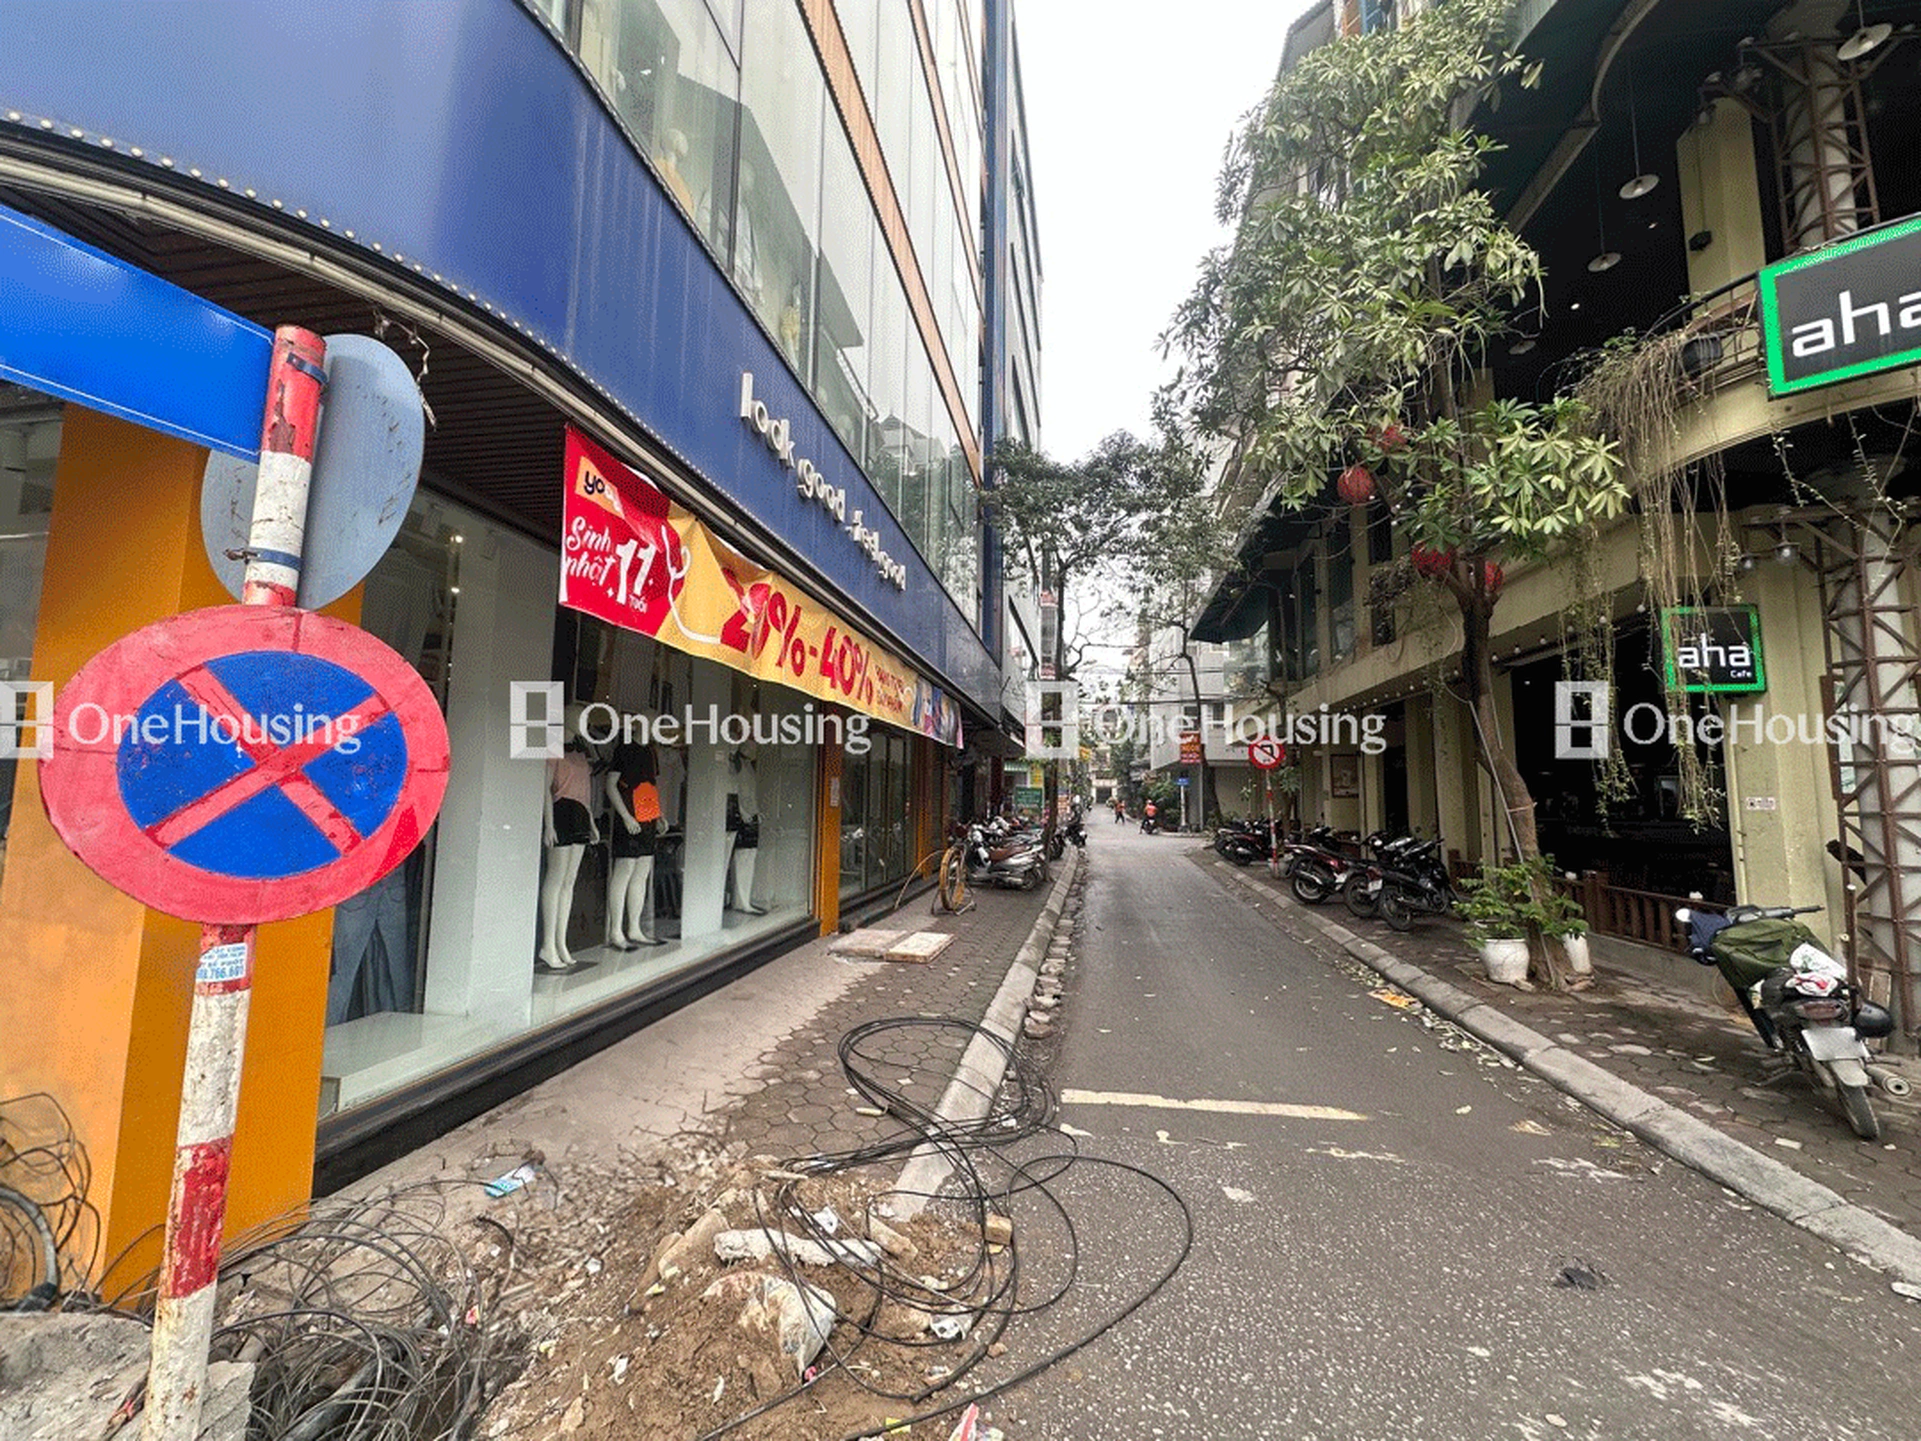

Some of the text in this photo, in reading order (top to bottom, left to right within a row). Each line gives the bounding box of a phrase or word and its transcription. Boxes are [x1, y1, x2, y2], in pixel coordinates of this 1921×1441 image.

[741, 372, 796, 469] look
[853, 510, 880, 561] feel
[878, 550, 906, 591] good
[567, 515, 612, 551] Sinh
[566, 551, 616, 587] nhật
[615, 537, 656, 605] 11
[1677, 632, 1751, 668] aha
[1730, 669, 1752, 679] Cafe
